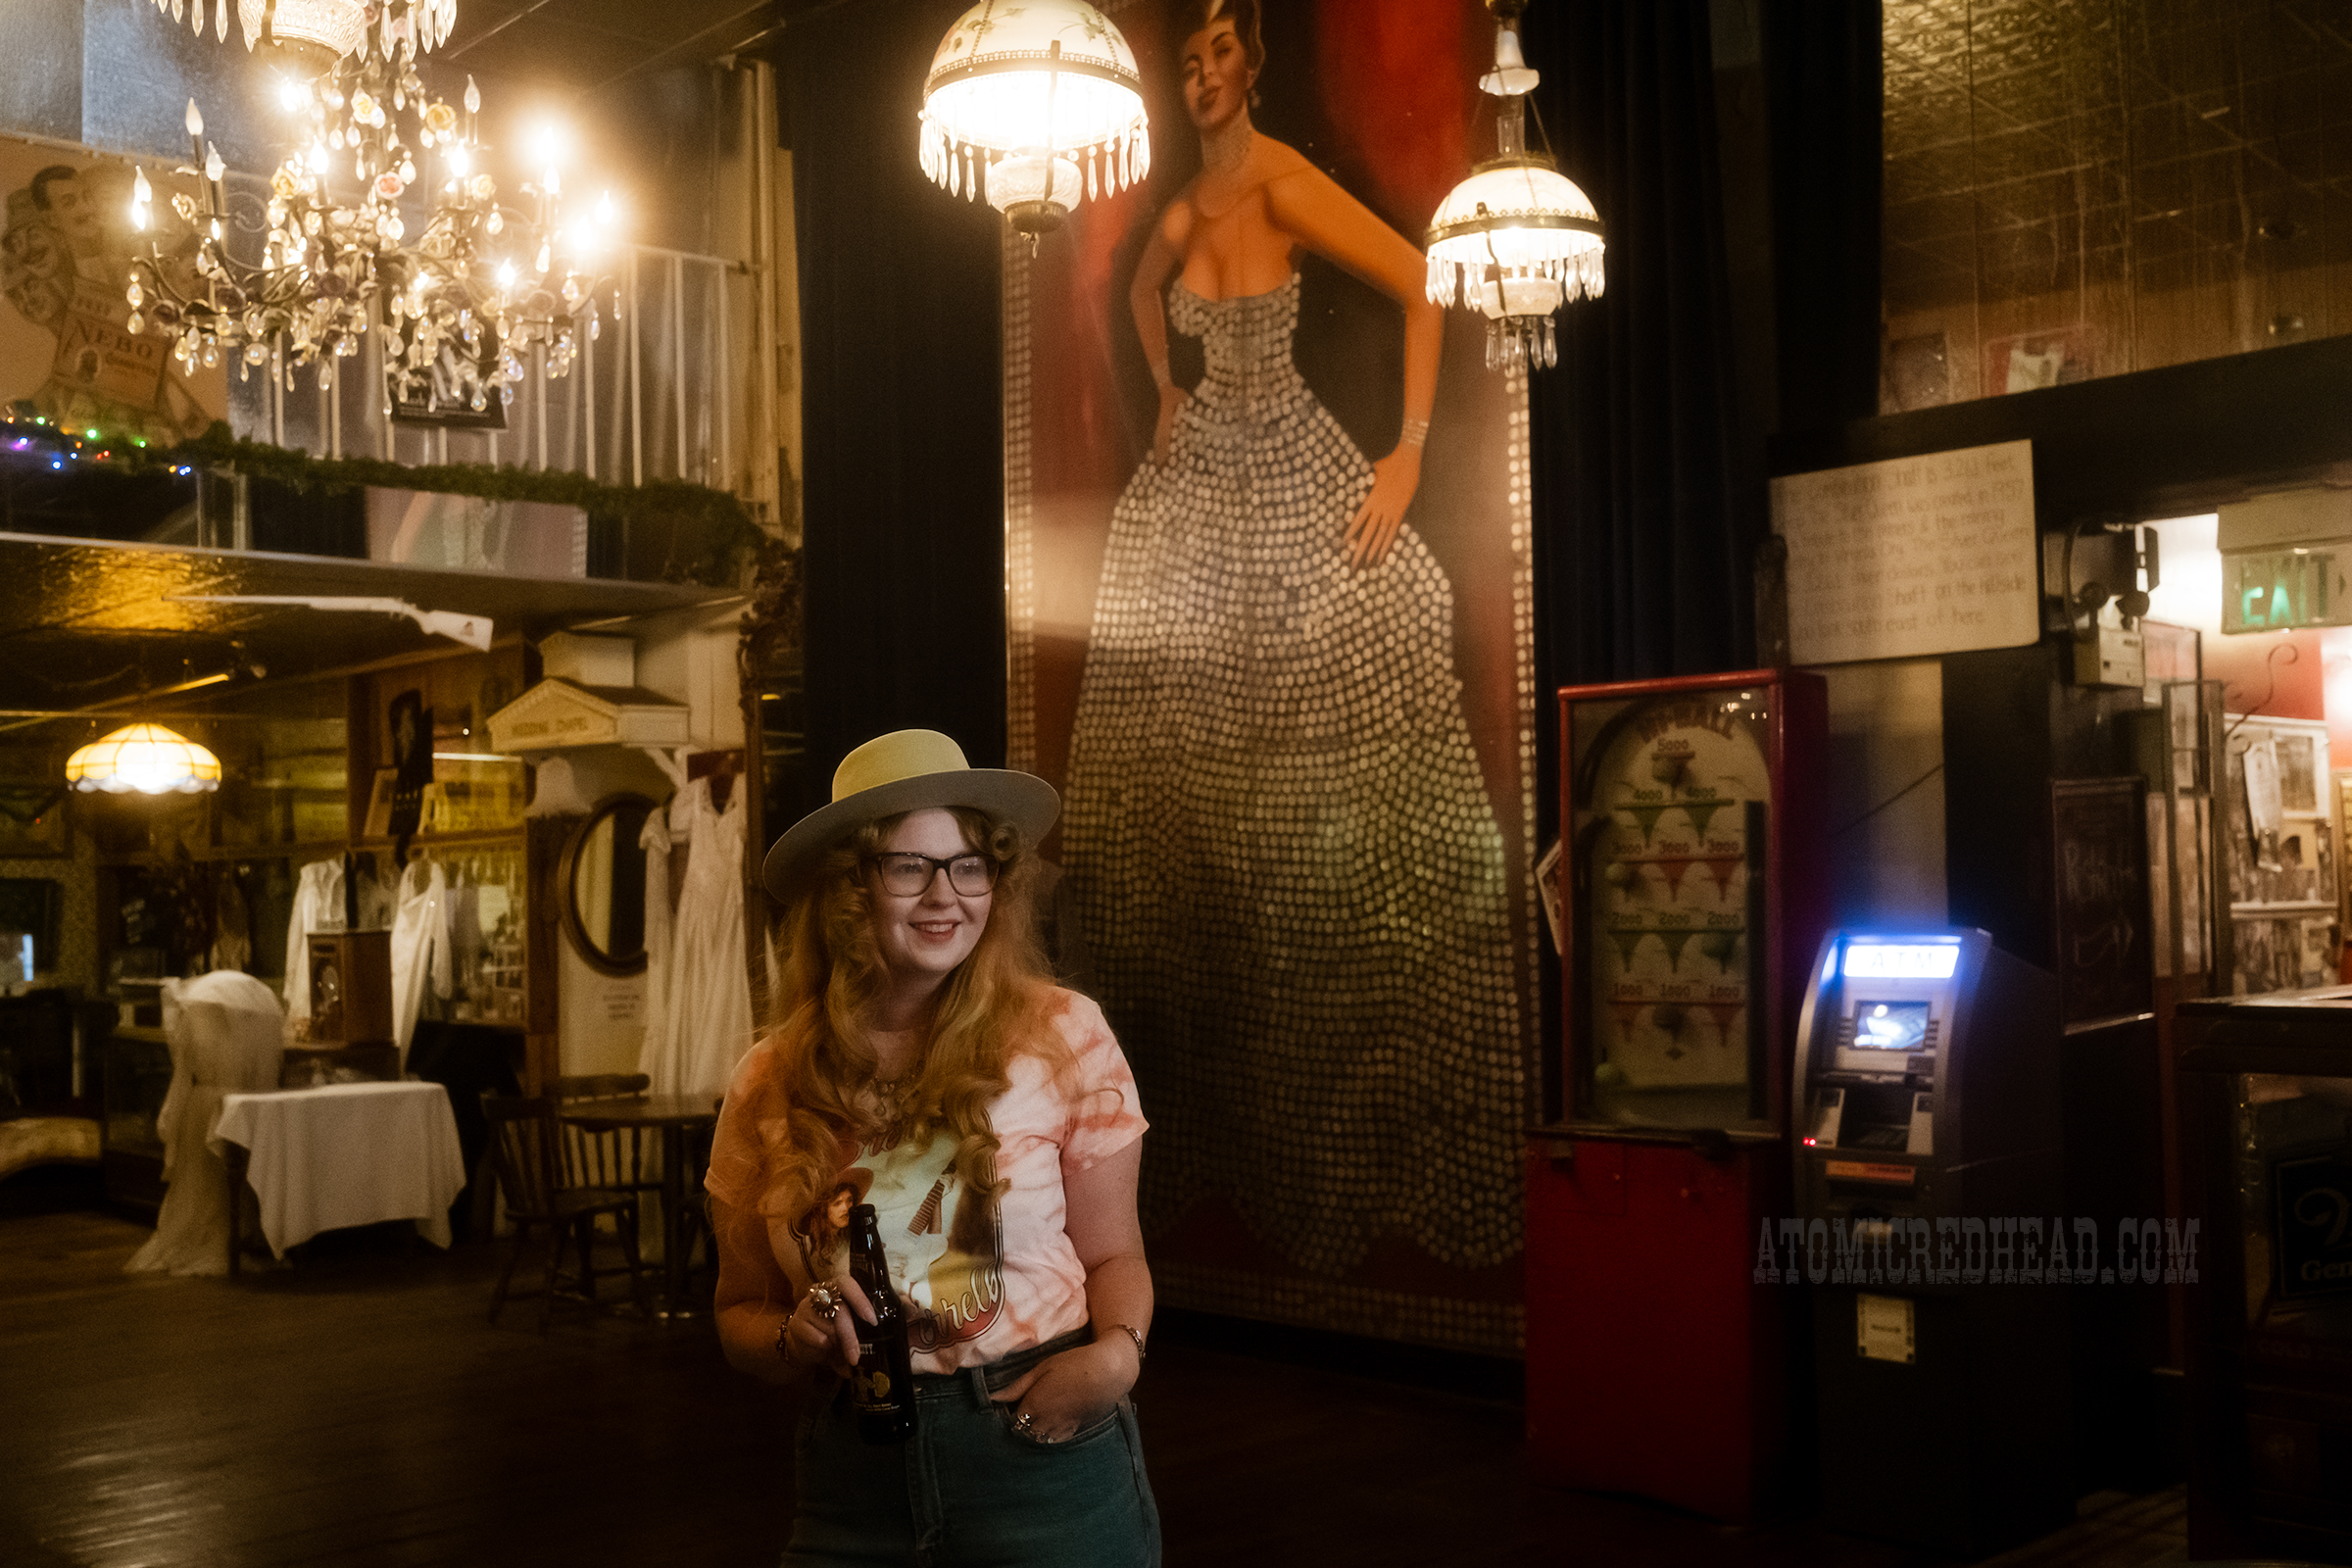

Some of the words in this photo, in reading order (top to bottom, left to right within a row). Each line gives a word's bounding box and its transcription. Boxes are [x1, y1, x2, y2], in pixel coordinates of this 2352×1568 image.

[1935, 512, 1955, 531] the
[1935, 582, 1951, 601] on
[1955, 578, 1976, 598] the
[2240, 553, 2336, 625] EXIT
[1657, 738, 1690, 752] 5000
[1633, 789, 1663, 802] 4000
[1686, 786, 1716, 799] 4000
[1612, 841, 1642, 856] 3000
[1658, 839, 1690, 855] 3000
[1707, 838, 1740, 854] 3000
[1612, 911, 1642, 925] 2000
[1659, 911, 1690, 925] 2000
[1707, 910, 1740, 925] 2000
[1871, 951, 1934, 971] ATM
[1613, 983, 1643, 997] 1000
[1660, 983, 1690, 998] 1000
[1709, 984, 1740, 999] 1000
